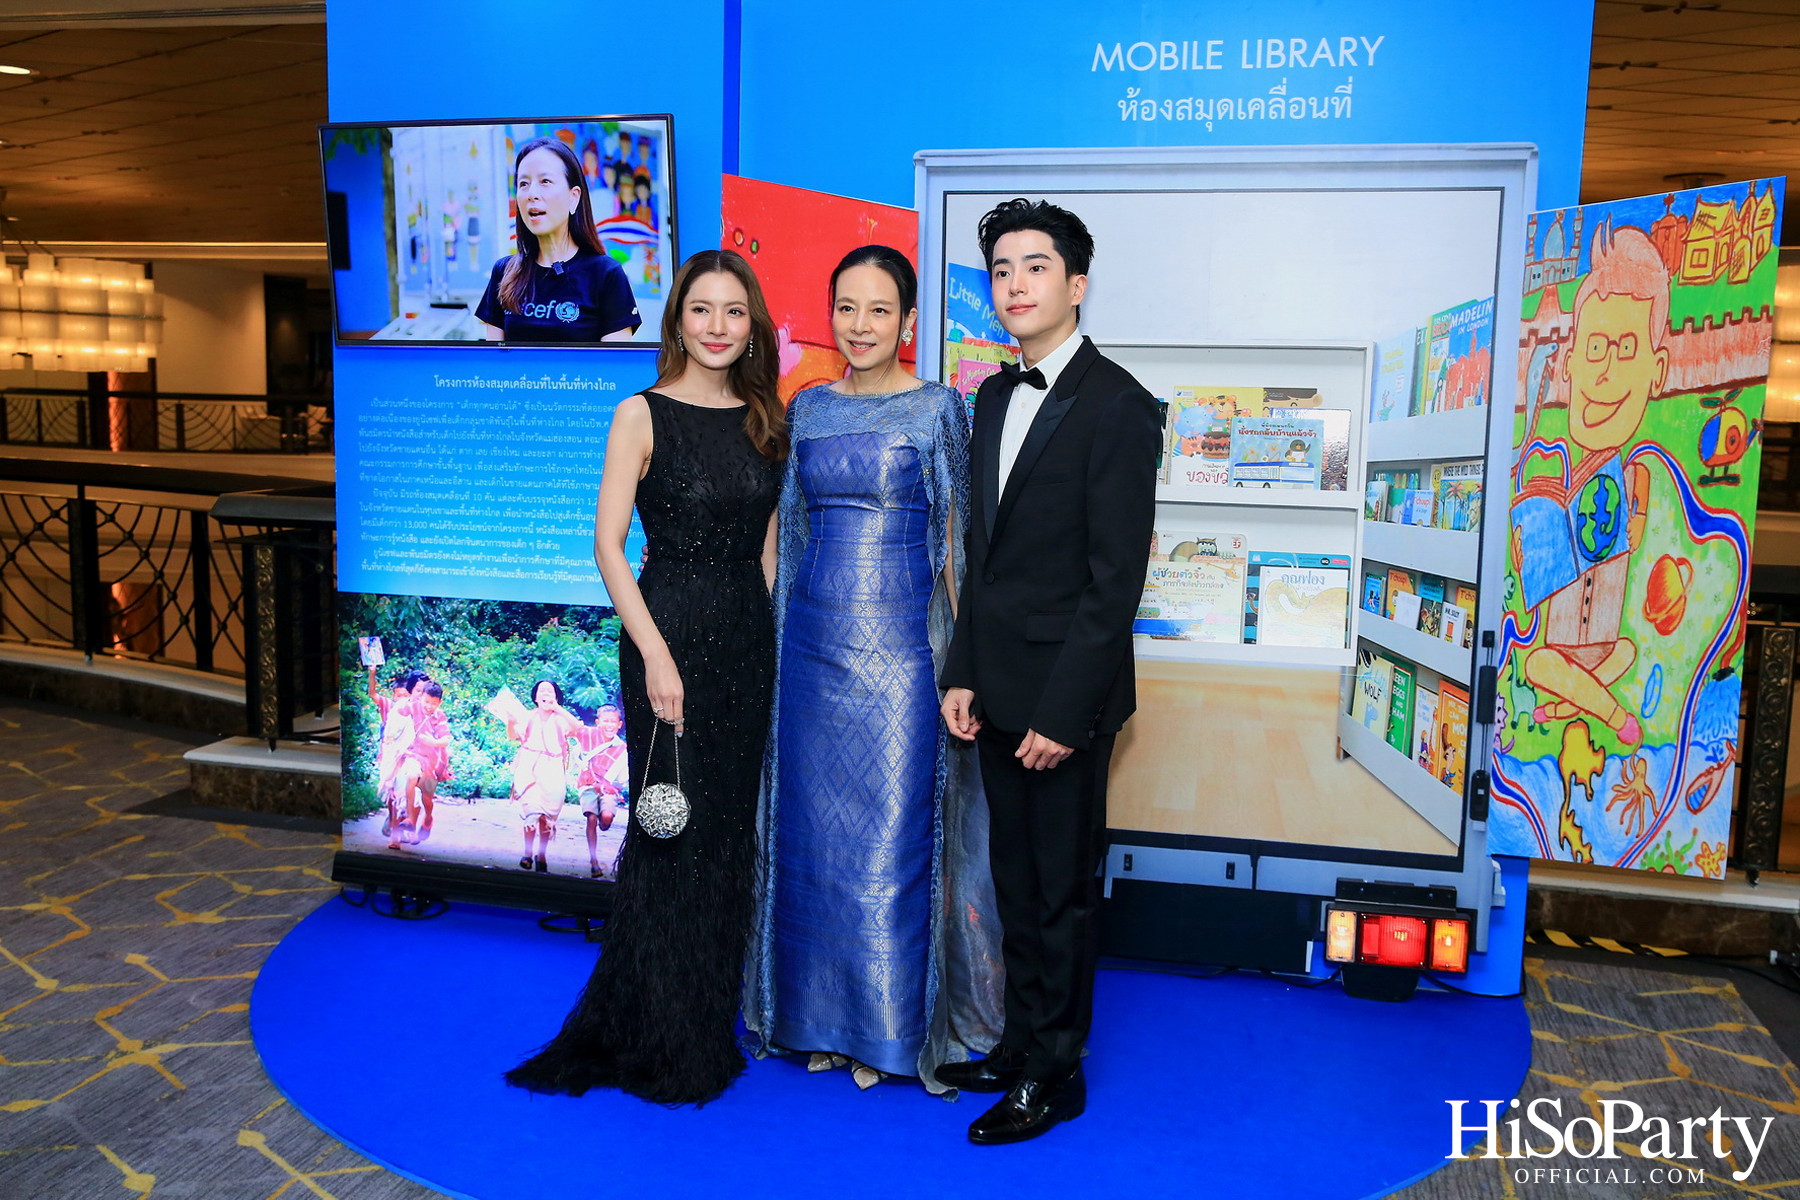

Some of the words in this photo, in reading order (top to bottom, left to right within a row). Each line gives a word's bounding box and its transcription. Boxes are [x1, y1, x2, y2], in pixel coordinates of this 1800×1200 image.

[1091, 40, 1224, 72] MOBILE
[1241, 36, 1386, 69] LIBRARY
[1117, 76, 1354, 132] ห้องสมุดเคลื่อนที่
[949, 277, 982, 311] Little
[1458, 325, 1466, 336] IN
[1467, 317, 1489, 332] LONDON
[434, 374, 617, 392] โครงการห้องสมุดเคลื่อนที่ในพื้นที่ห่างไกล
[473, 493, 483, 501] 10
